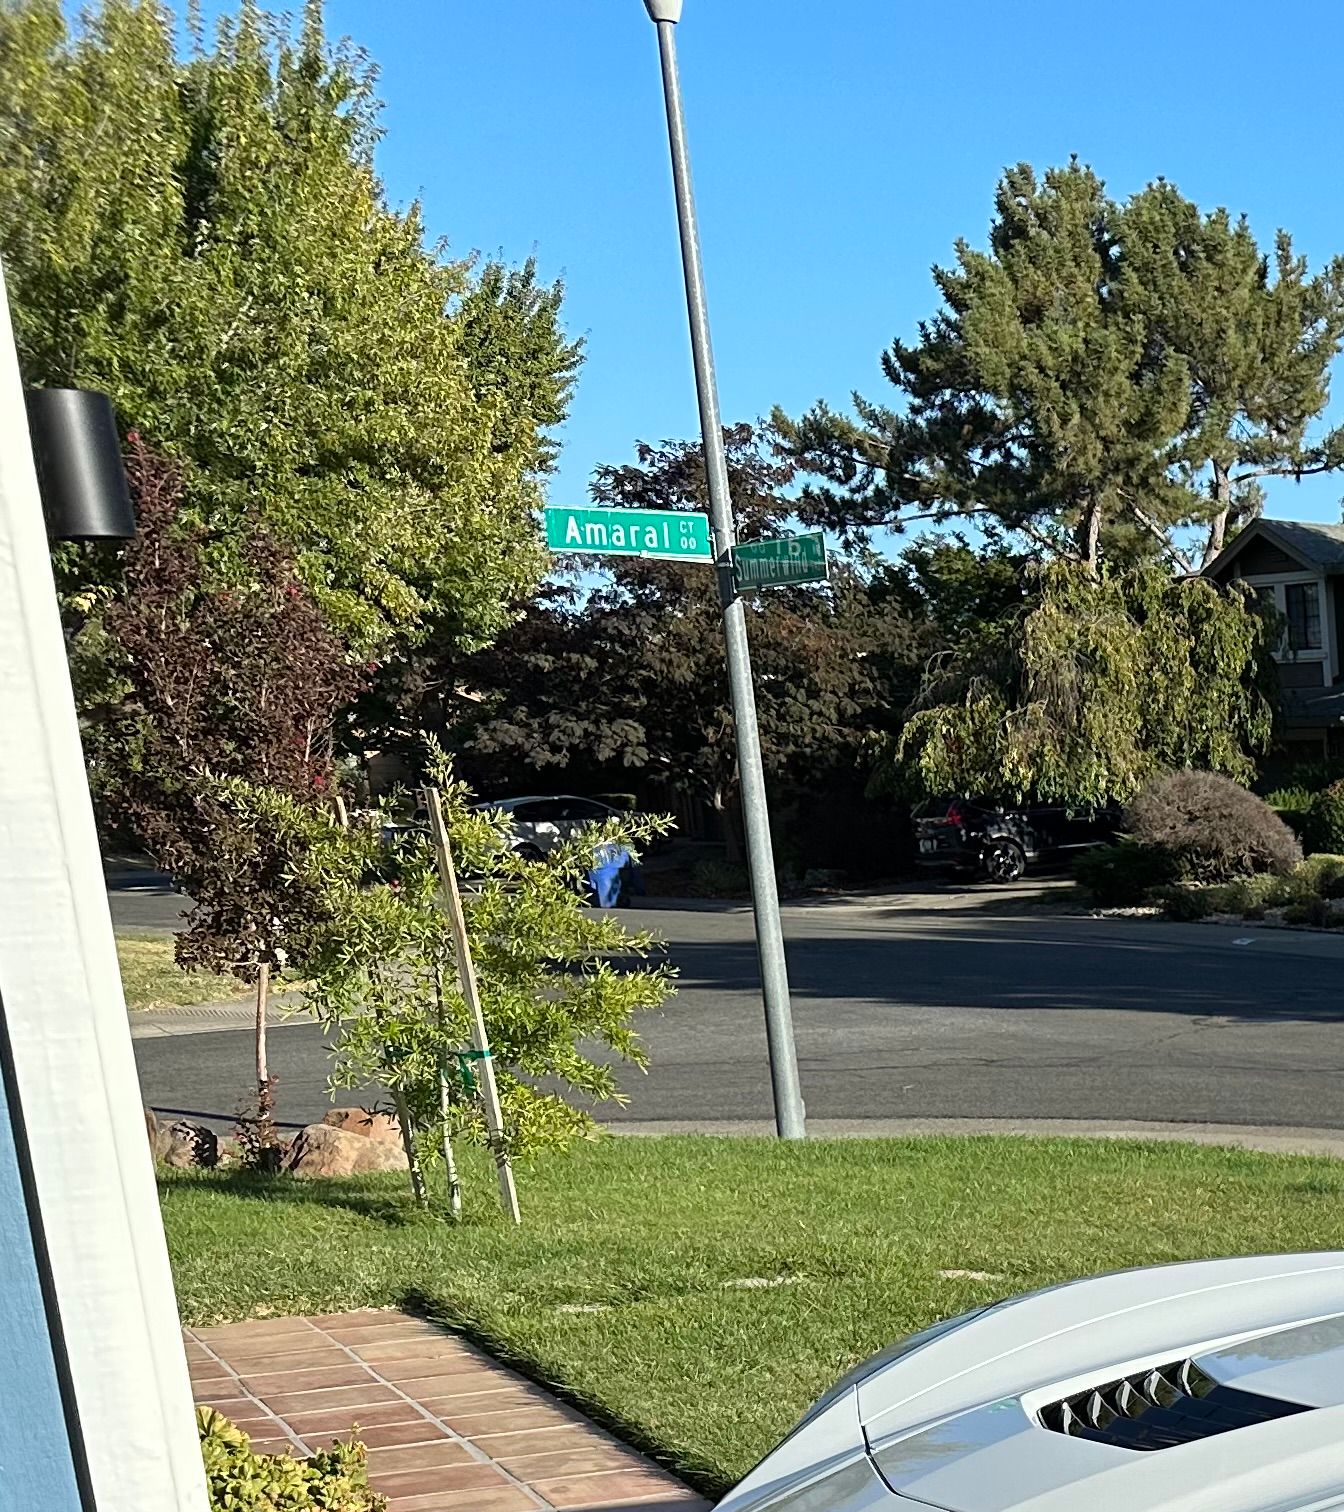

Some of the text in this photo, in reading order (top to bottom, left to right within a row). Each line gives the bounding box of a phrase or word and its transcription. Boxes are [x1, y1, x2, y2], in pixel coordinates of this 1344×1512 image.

[565, 515, 671, 549] Amaral
[680, 521, 695, 535] CT
[735, 551, 809, 582] Summerwind
